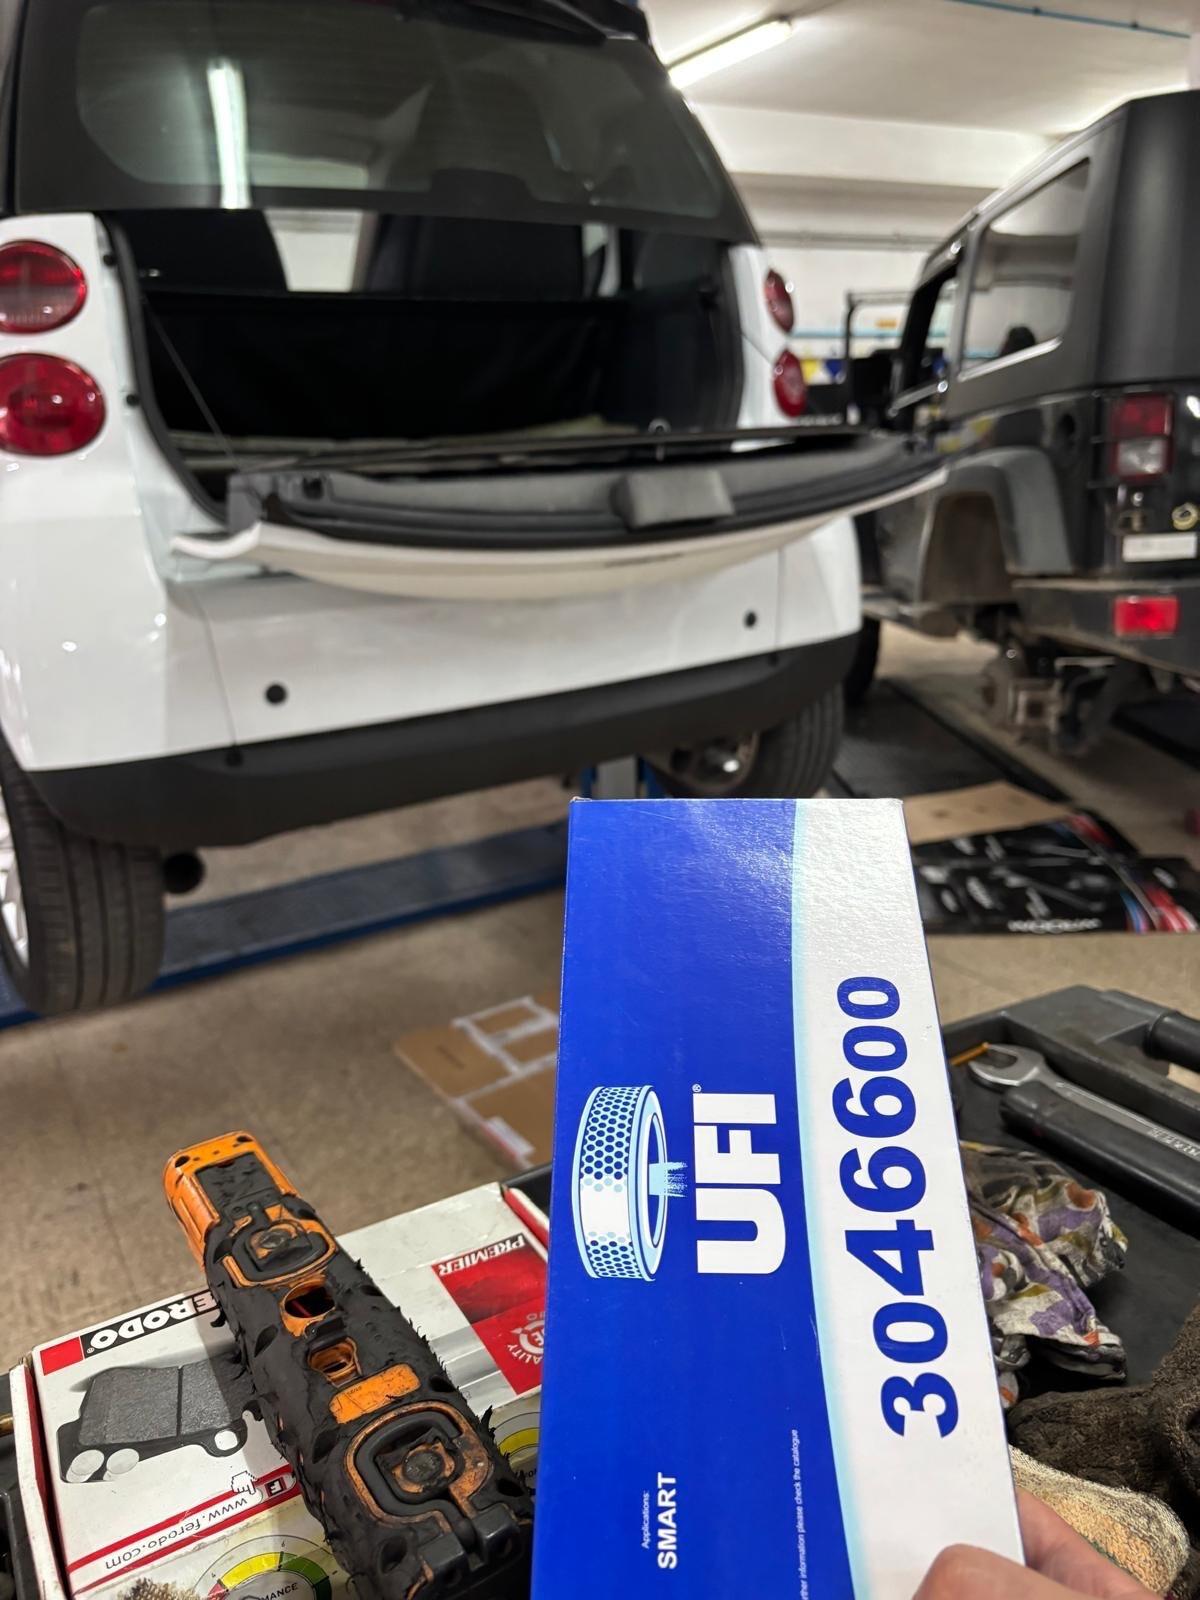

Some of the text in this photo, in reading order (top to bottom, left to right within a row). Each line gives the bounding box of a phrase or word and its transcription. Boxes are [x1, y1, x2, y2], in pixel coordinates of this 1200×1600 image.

[692, 1092, 786, 1275] UFI
[832, 976, 959, 1437] 3046600
[438, 1235, 526, 1276] PREMIER
[90, 1291, 217, 1350] ERODO
[507, 1343, 543, 1365] ALITY
[105, 1497, 248, 1570] www.ferodo.com
[641, 1490, 651, 1550] Applications:
[657, 1471, 678, 1570] SMART
[791, 1429, 809, 1600] rther information please check the catalogue
